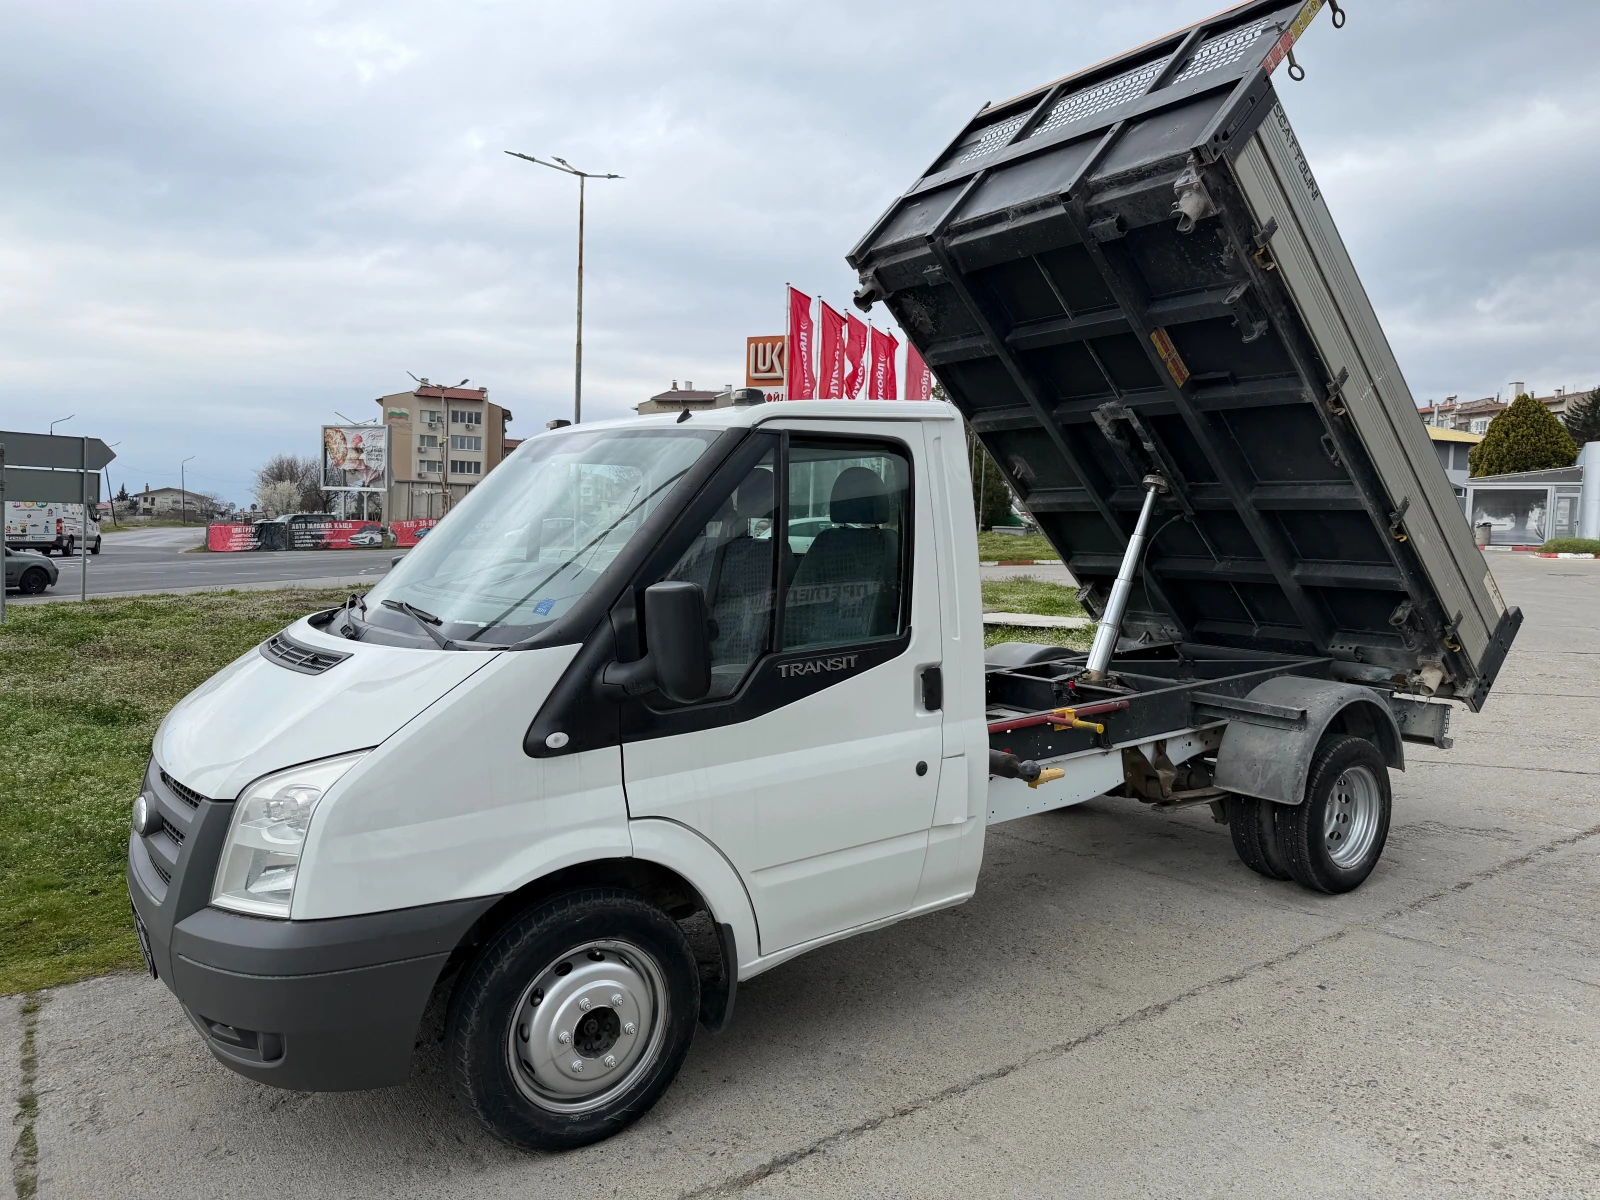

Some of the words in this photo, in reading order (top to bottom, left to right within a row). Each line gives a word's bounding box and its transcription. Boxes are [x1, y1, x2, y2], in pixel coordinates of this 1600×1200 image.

[1273, 104, 1320, 201] SCATTOLINI
[876, 362, 886, 400] УКОЙЛ
[921, 369, 930, 400] КОЙЛ
[777, 654, 859, 678] TRANSIT
